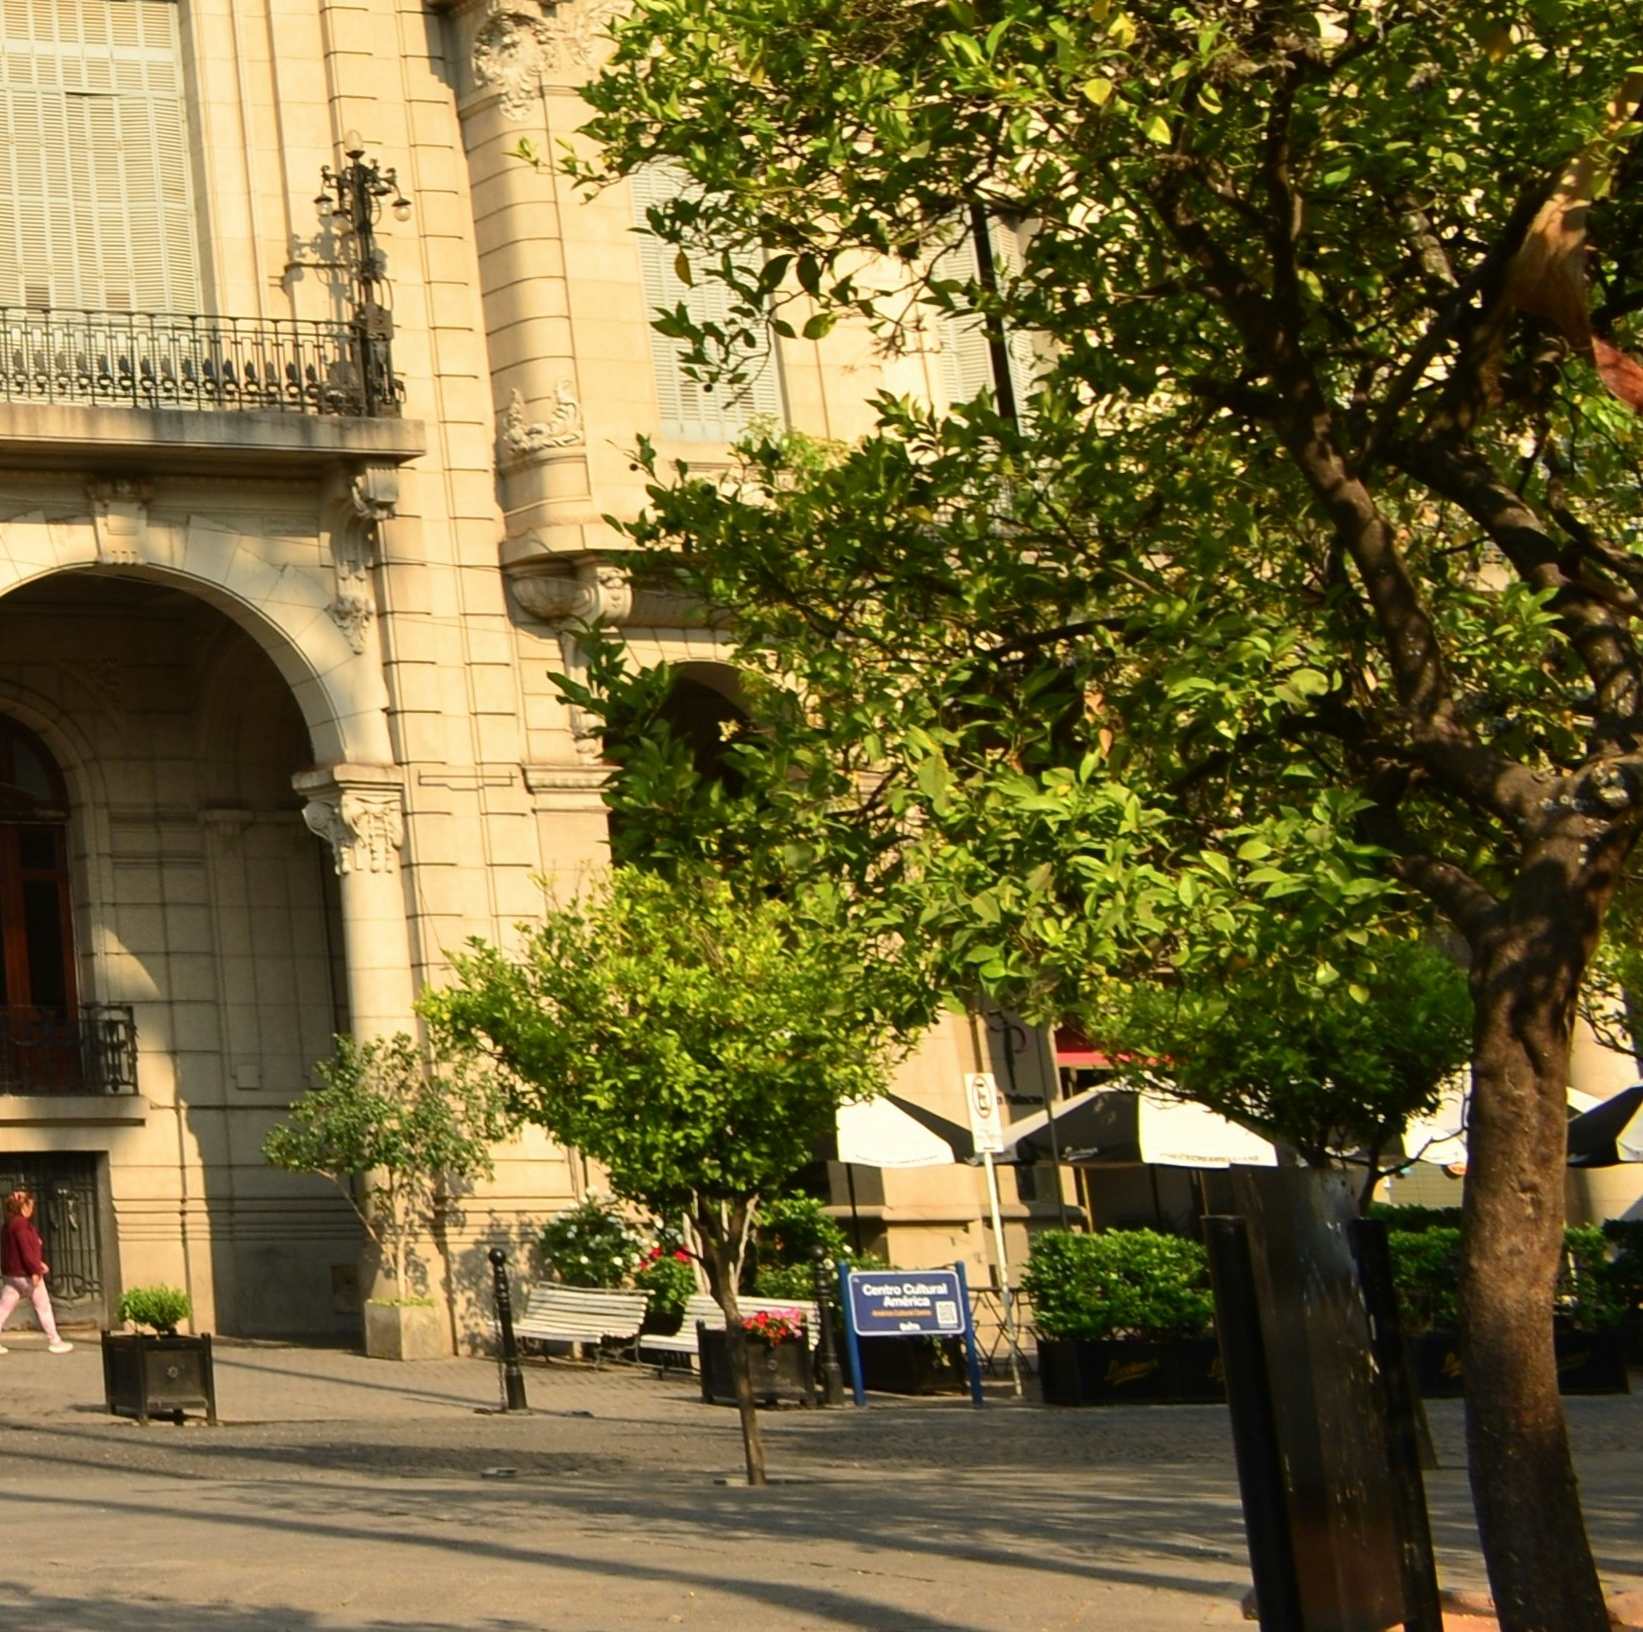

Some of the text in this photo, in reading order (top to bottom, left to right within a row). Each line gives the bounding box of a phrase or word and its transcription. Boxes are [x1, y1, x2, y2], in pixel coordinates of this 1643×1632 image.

[862, 1282, 948, 1297] Centro Cultural
[883, 1296, 931, 1307] América
